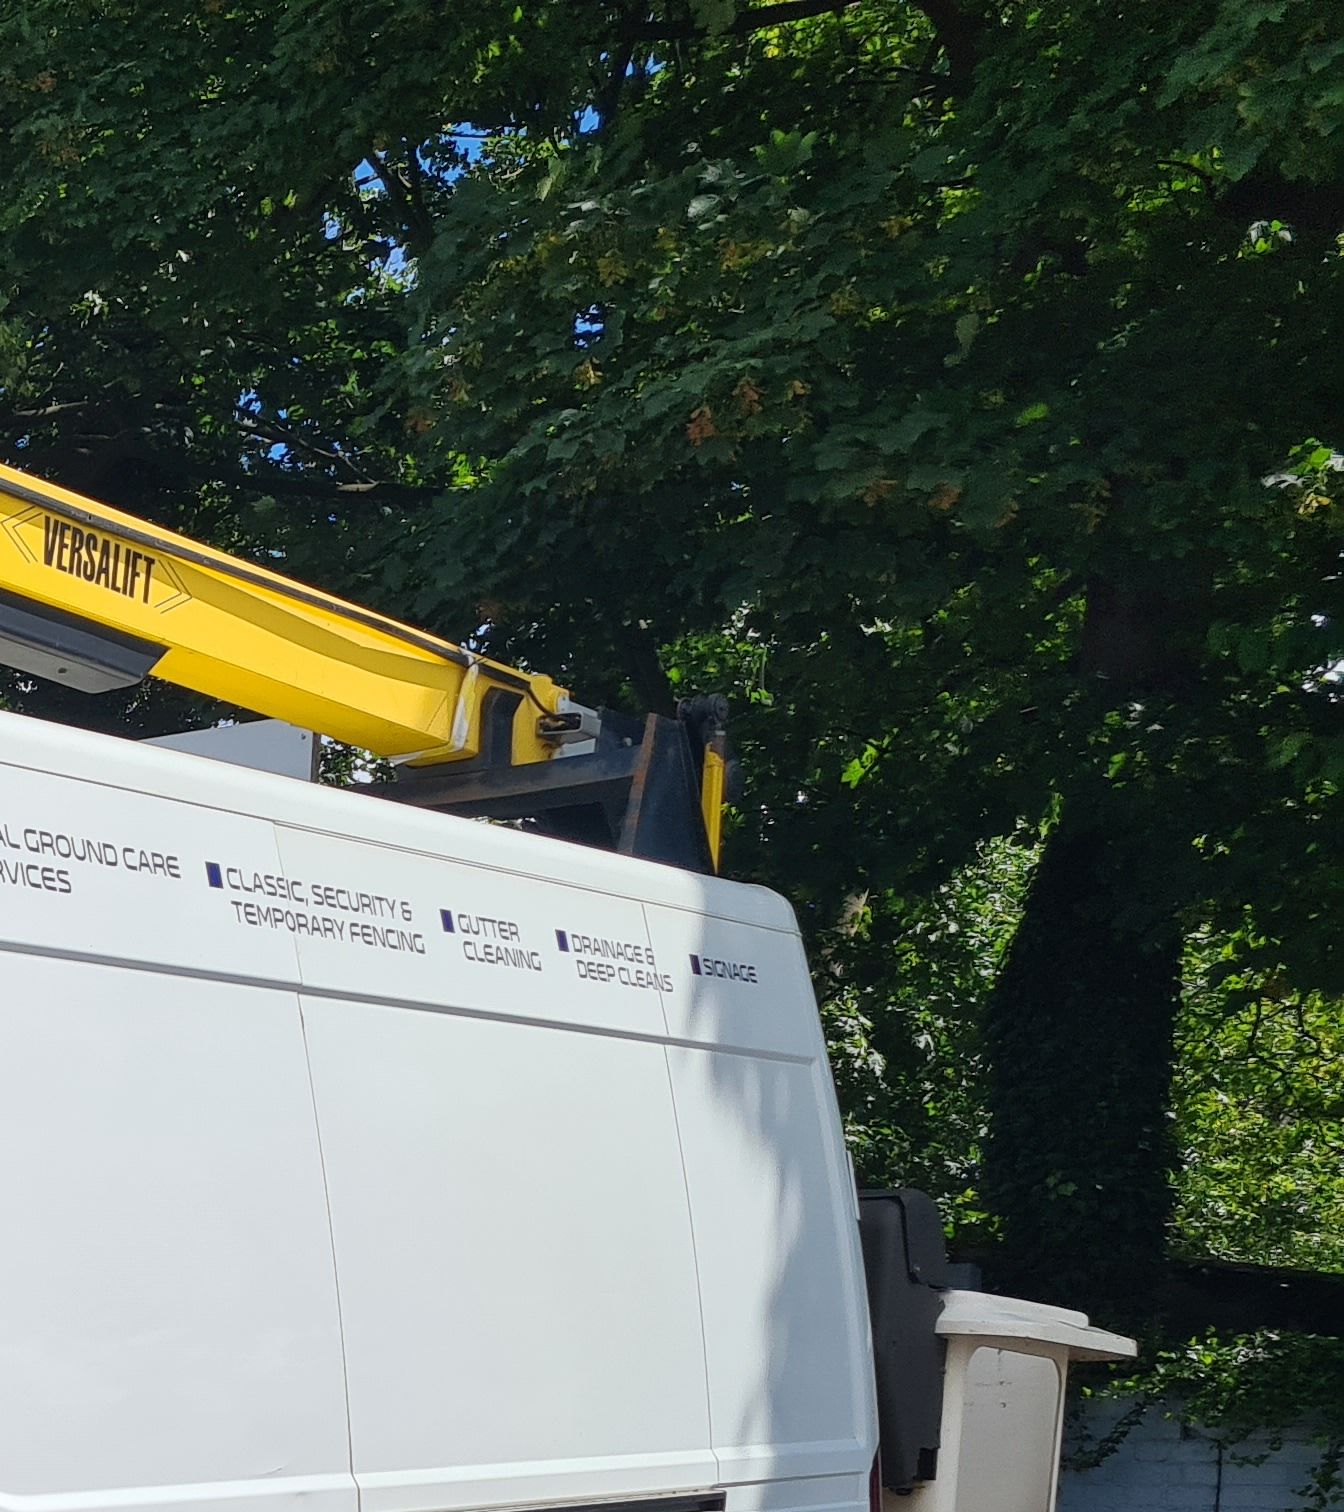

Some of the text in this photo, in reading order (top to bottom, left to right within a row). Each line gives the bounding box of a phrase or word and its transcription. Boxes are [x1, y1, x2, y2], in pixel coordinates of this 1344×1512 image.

[43, 516, 156, 604] VERSALIFT
[24, 828, 118, 866] GROUND
[123, 847, 181, 879] CARE
[226, 867, 412, 922] CLASSIC, SECURITY &
[231, 901, 425, 955] TEMPORARY FENCING
[458, 914, 520, 943] GUTTER
[463, 941, 542, 972] CLEANING
[571, 934, 655, 965] DRAINAGE &
[576, 959, 673, 993] DEEP CLEANS
[704, 957, 758, 984] SIGNAGE
